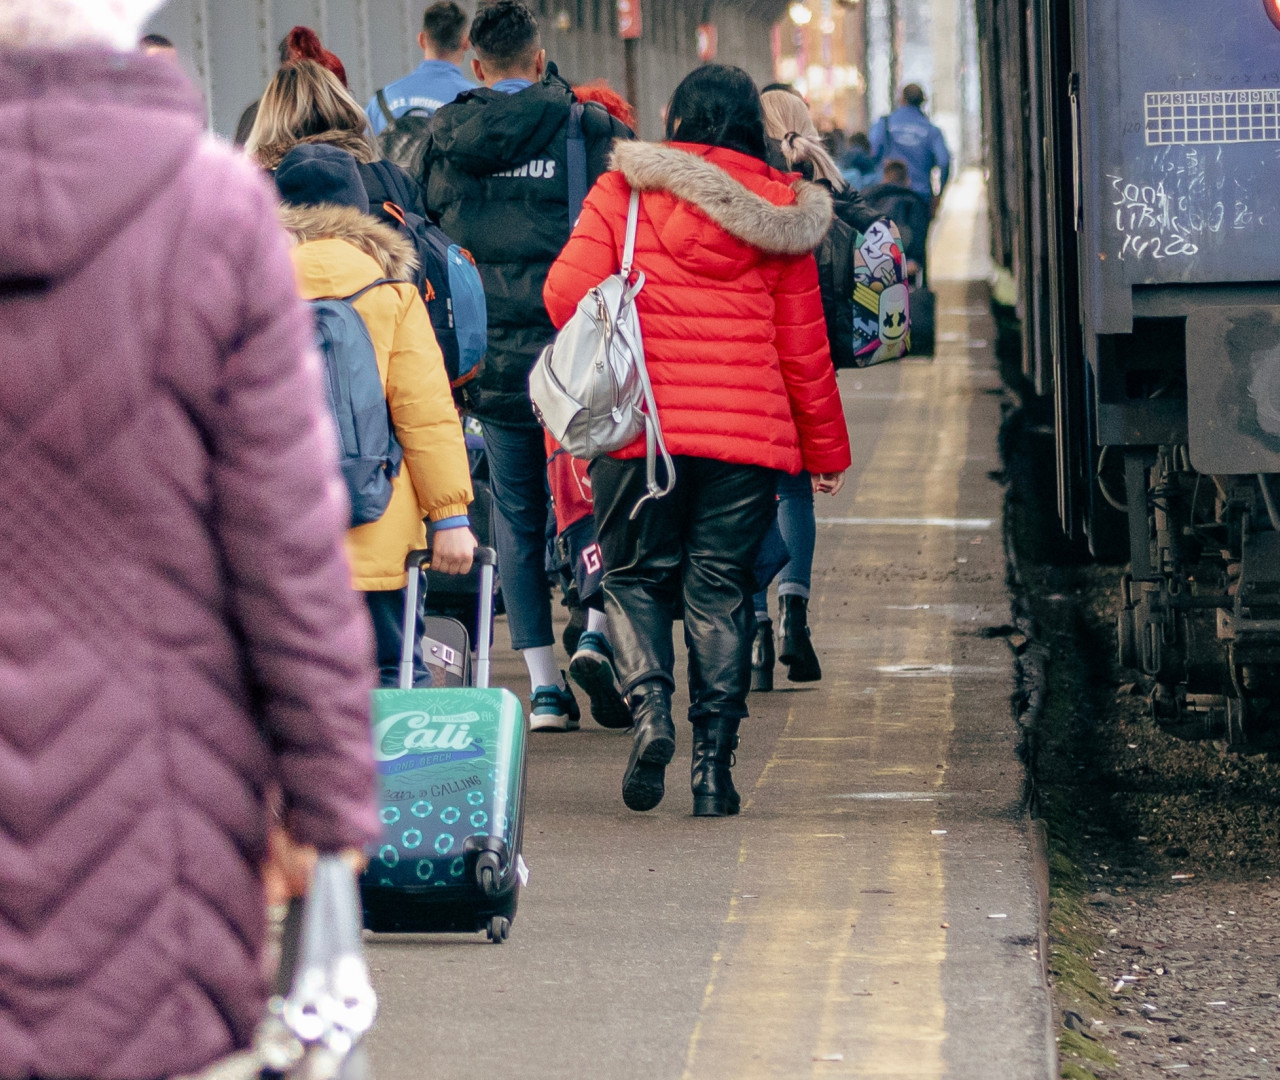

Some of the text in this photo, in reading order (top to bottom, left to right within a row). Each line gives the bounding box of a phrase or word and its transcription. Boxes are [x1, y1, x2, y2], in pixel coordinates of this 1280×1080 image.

[1149, 95, 1156, 105] 1
[1162, 95, 1169, 105] 2
[1174, 94, 1182, 104] 3
[1187, 94, 1195, 104] 4
[1201, 93, 1209, 103] 5
[1213, 93, 1221, 103] 6
[1226, 93, 1234, 103] 7
[1239, 92, 1247, 102] 8
[1252, 91, 1261, 102] 9
[1264, 91, 1275, 101] 10
[374, 710, 474, 762] Cali
[388, 753, 453, 774] LONG BEACH
[430, 774, 483, 798] CALLING
